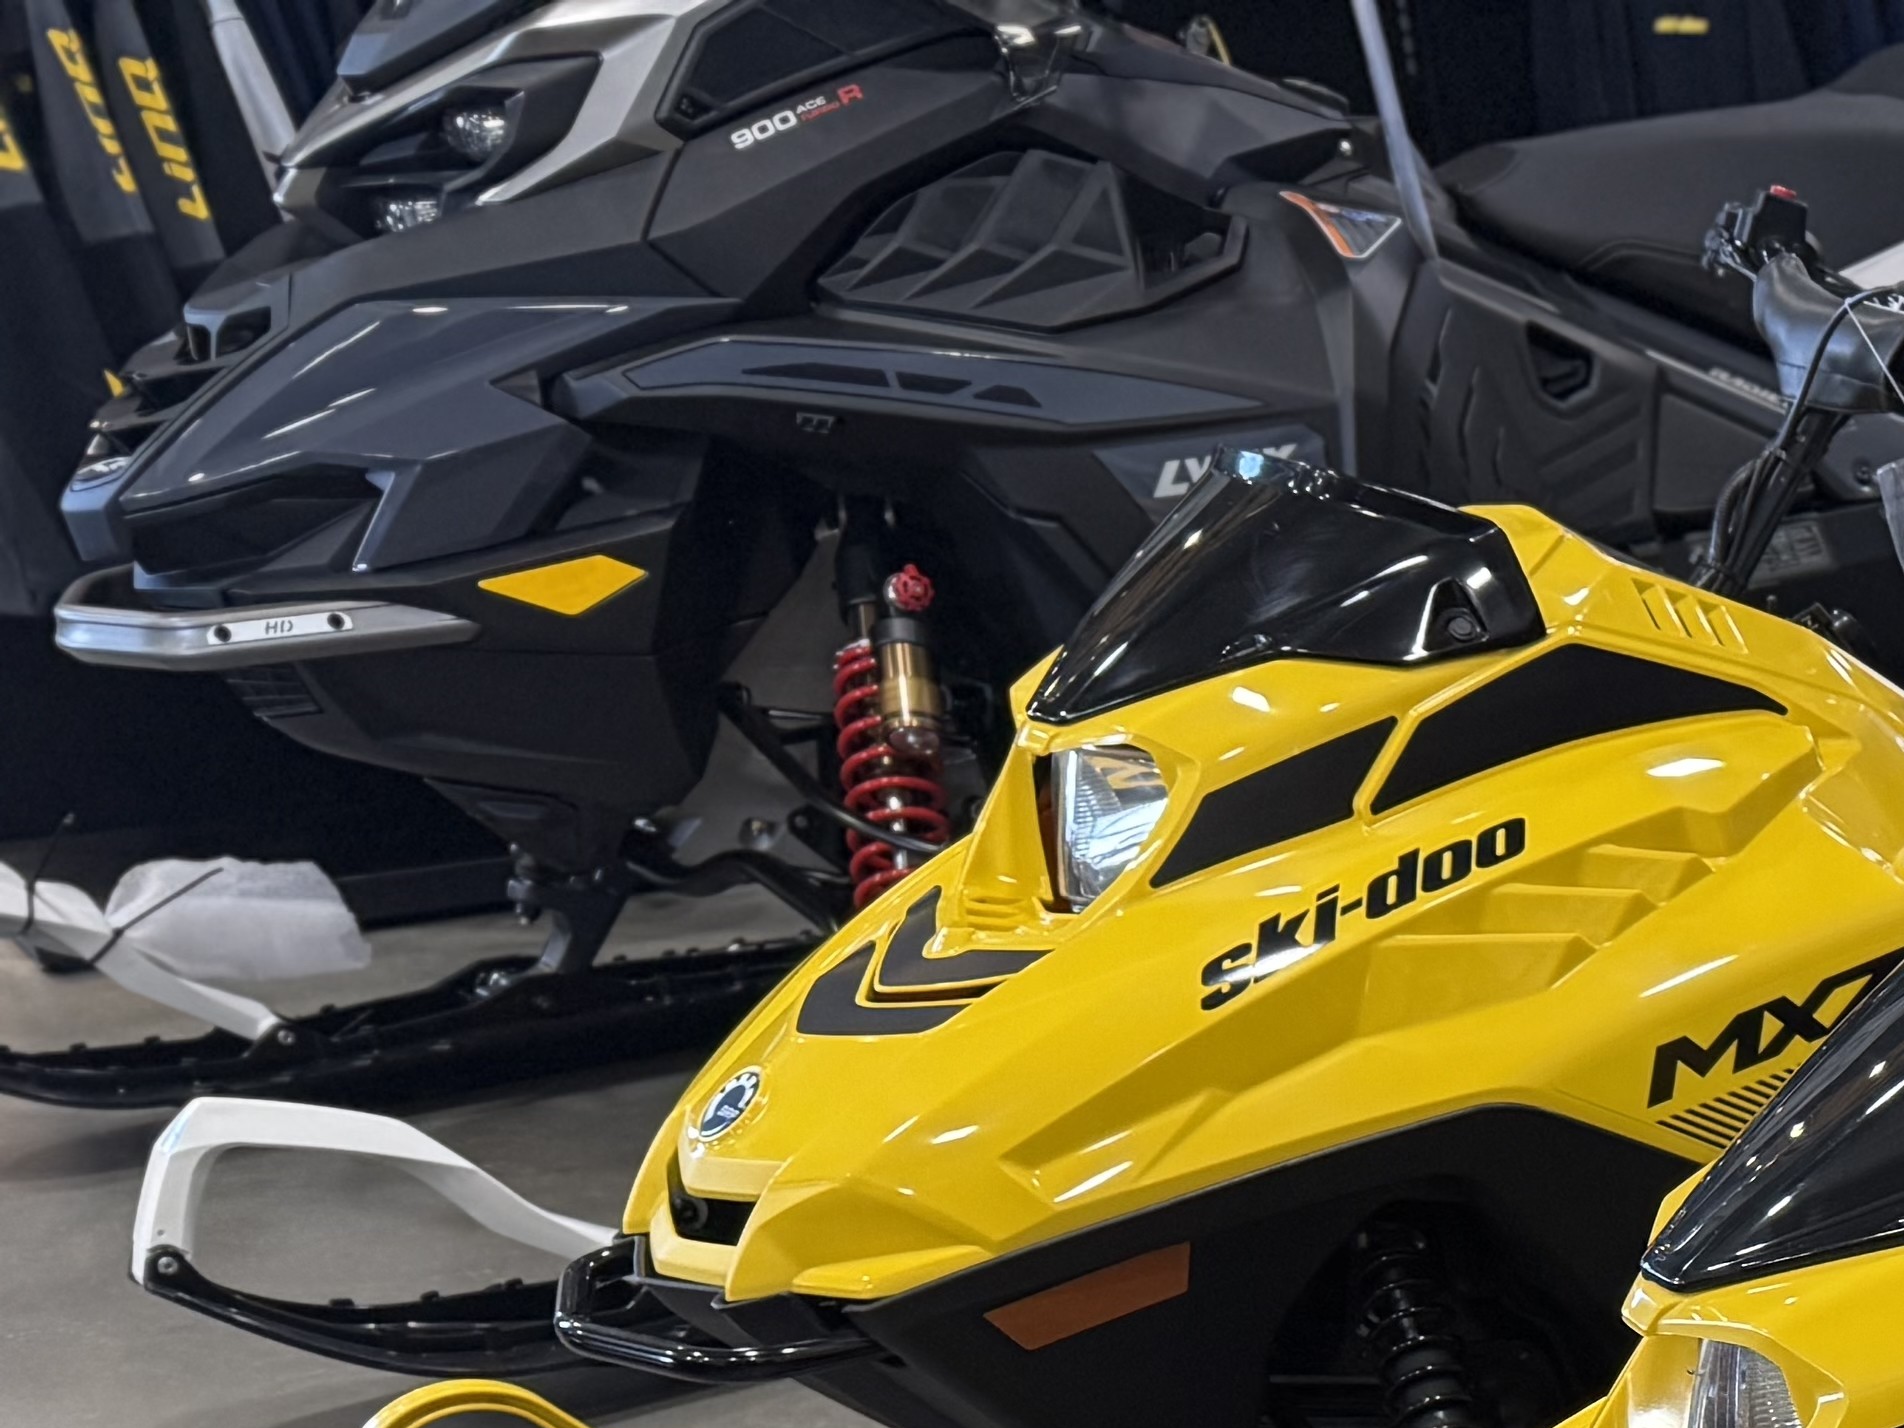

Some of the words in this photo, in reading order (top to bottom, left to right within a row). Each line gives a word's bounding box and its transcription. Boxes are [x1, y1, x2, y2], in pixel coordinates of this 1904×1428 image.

[730, 110, 798, 149] 900
[796, 96, 827, 114] ACE
[837, 84, 864, 107] R
[265, 620, 293, 635] HD
[1201, 817, 1527, 1011] ski-doo
